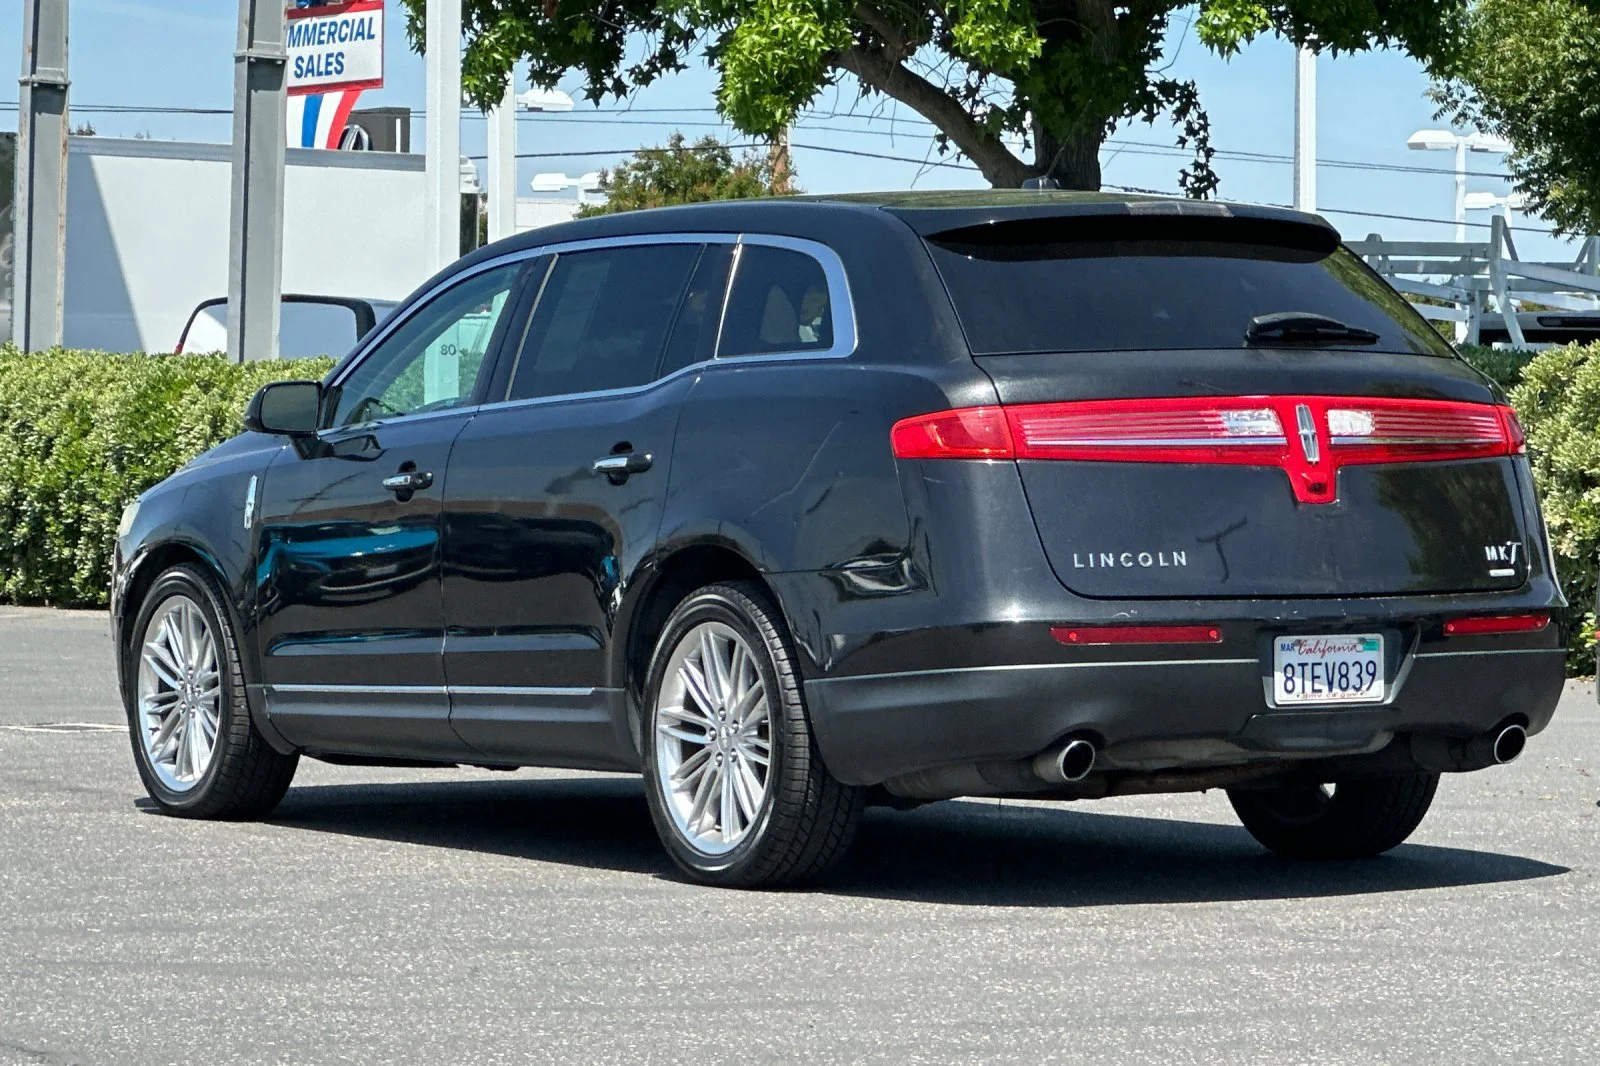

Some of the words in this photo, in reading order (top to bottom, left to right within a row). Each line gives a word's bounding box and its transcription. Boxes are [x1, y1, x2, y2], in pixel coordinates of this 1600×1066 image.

[294, 51, 345, 79] SALES
[441, 344, 456, 356] 80
[1073, 551, 1187, 568] LINCOLN
[1484, 541, 1522, 565] MKT
[1280, 643, 1295, 652] MAR
[1298, 639, 1362, 659] California
[1283, 660, 1377, 694] 8TEV839
